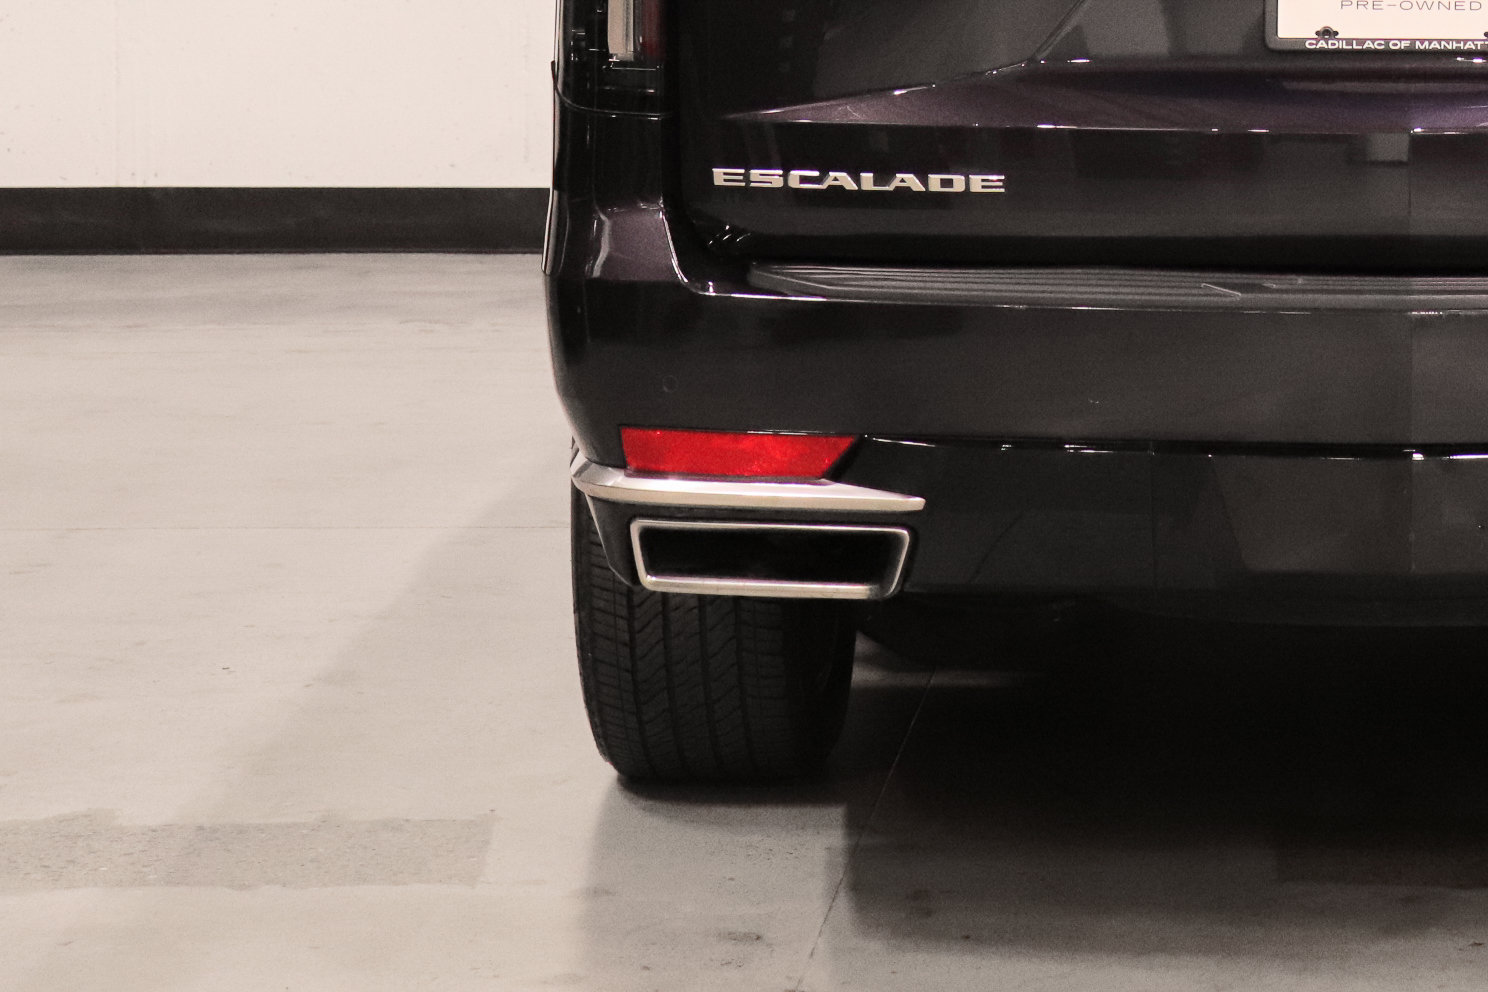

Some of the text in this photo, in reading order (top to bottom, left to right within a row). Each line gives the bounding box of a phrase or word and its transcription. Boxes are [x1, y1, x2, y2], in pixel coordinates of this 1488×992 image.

[1340, 0, 1483, 11] PRE-OWNED
[1305, 40, 1385, 50] CADILLAC
[1388, 40, 1410, 50] OF
[711, 168, 1006, 193] ESCALADE
